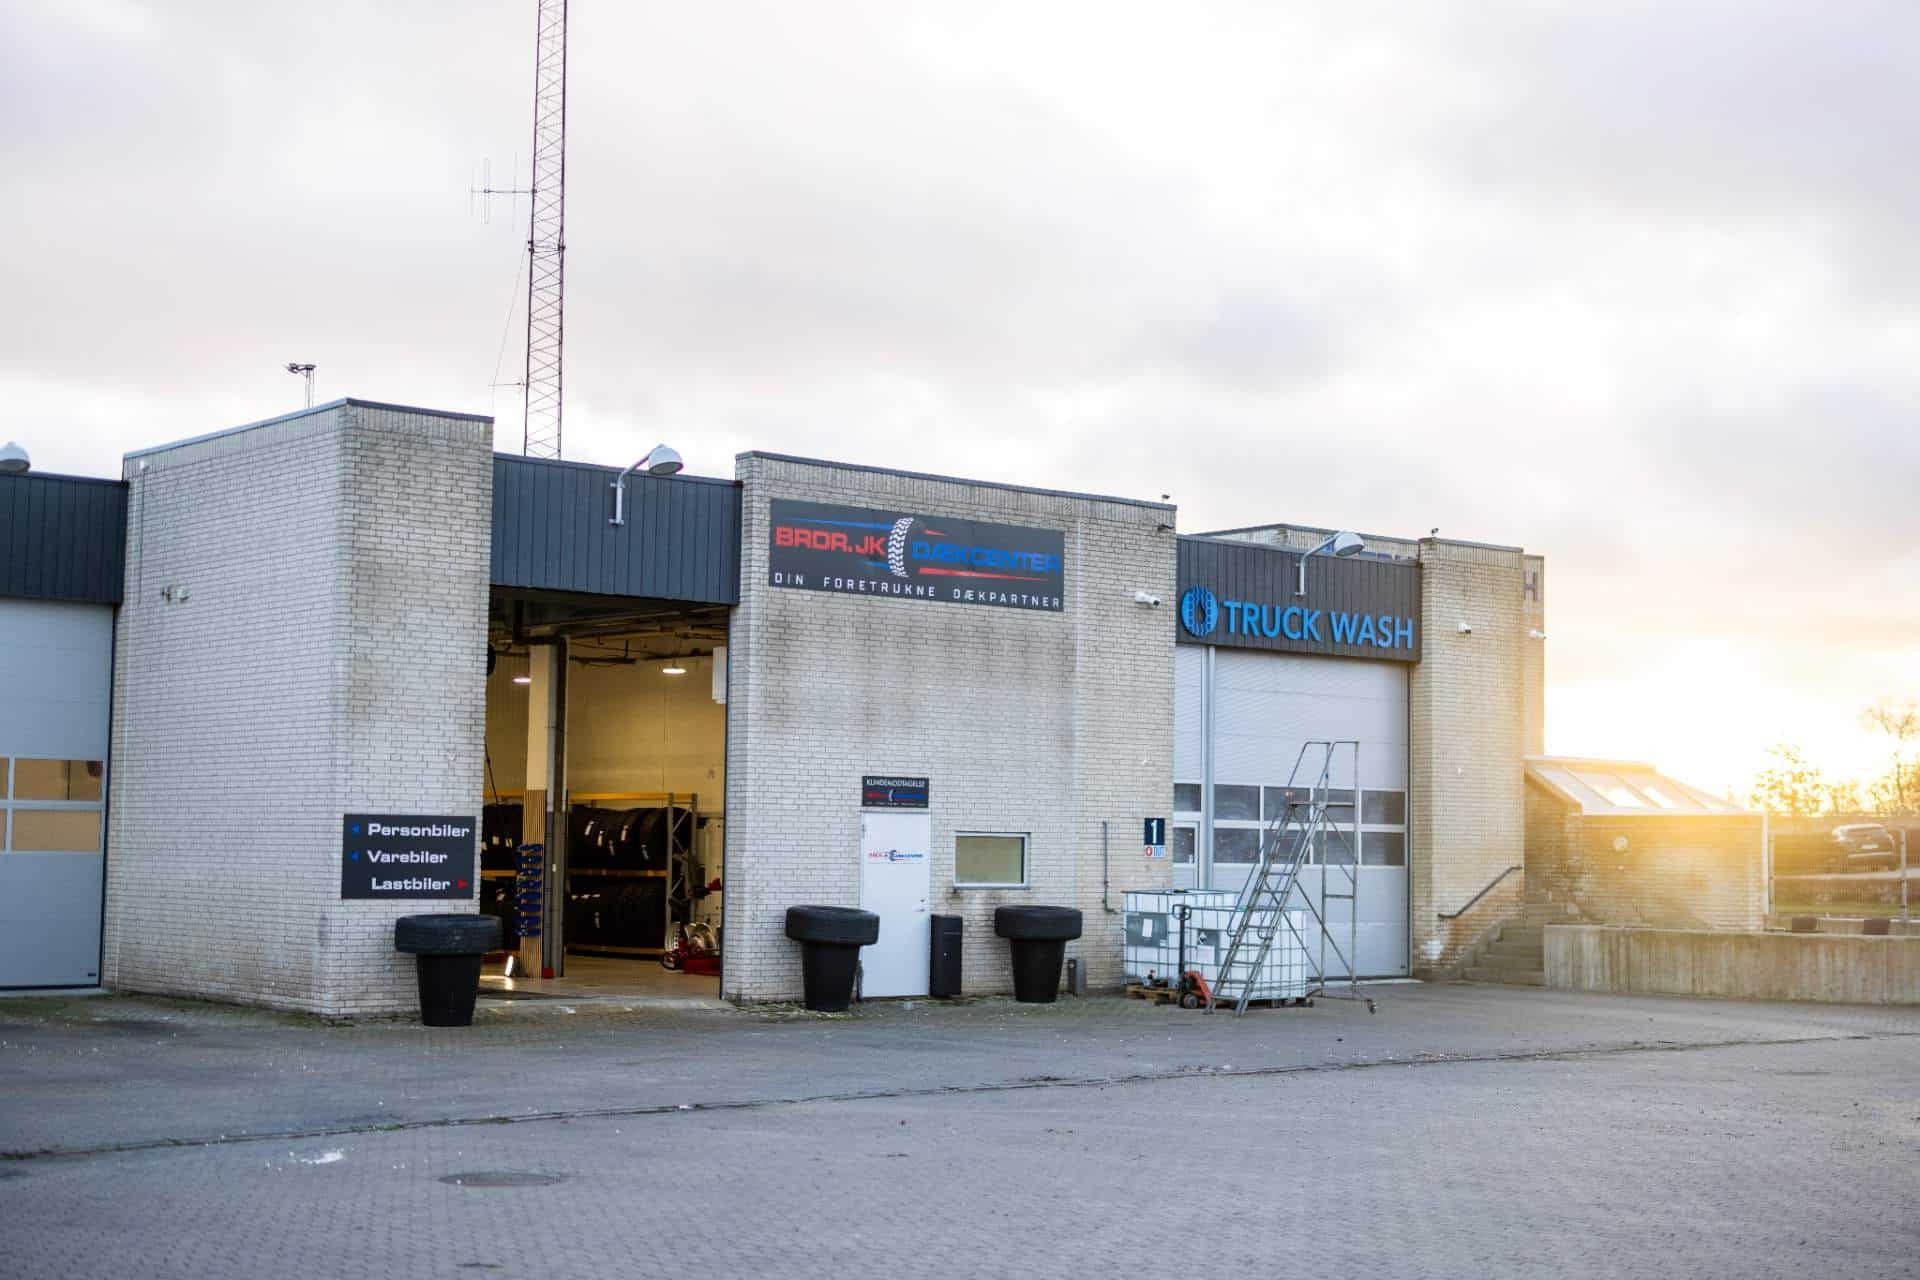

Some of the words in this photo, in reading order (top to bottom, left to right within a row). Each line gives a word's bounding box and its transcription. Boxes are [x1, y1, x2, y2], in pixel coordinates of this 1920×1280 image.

[911, 540, 1062, 574] DÆKCENTER
[774, 572, 804, 586] DIN
[823, 576, 936, 597] FORETRUKNE
[953, 588, 1060, 608] DÆKPARTNER
[1223, 600, 1321, 641] TRUCK
[1329, 612, 1414, 649] WASH
[367, 823, 470, 837] Personbiler
[1150, 819, 1158, 845] 1
[367, 850, 448, 864] Varebiler
[371, 877, 451, 891] Lastbiler
